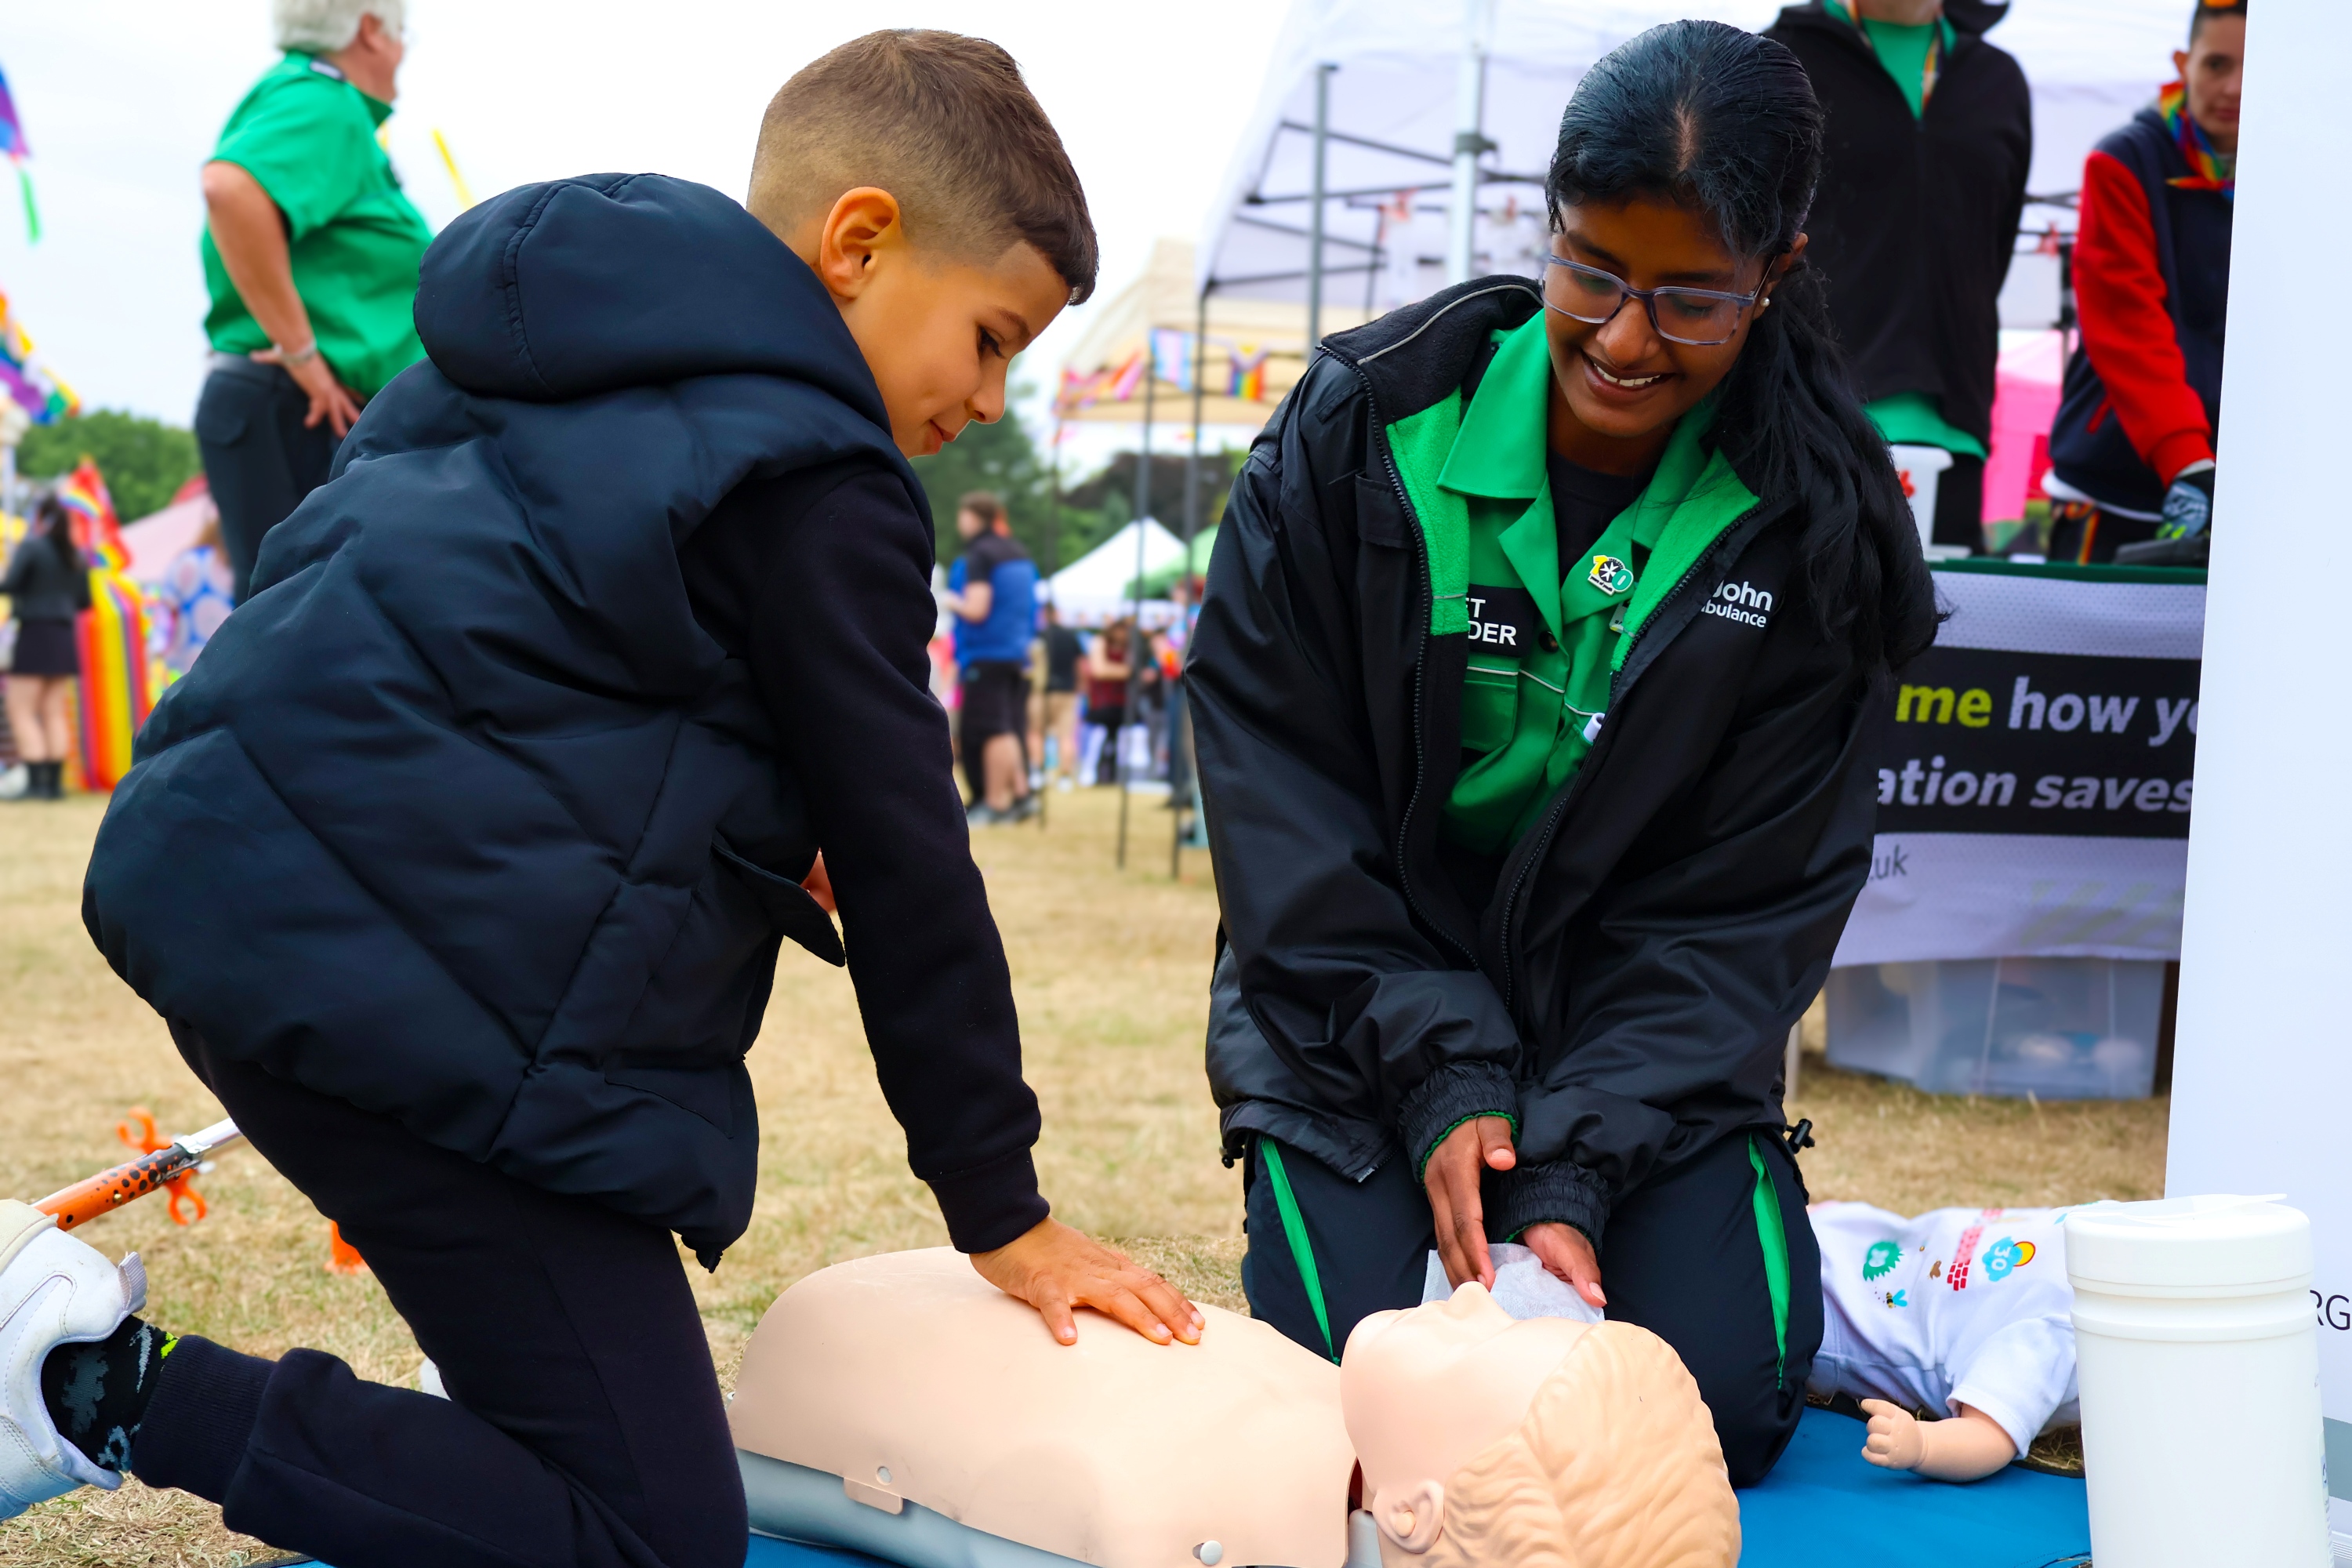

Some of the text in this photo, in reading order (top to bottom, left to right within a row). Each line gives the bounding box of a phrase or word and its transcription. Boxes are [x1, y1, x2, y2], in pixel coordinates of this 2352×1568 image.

[1465, 597, 1486, 619] T
[1701, 599, 1767, 628] bulance
[1895, 683, 1993, 728] me
[2008, 676, 2140, 733] how
[2029, 774, 2194, 813] saves
[1991, 1246, 2013, 1272] 30
